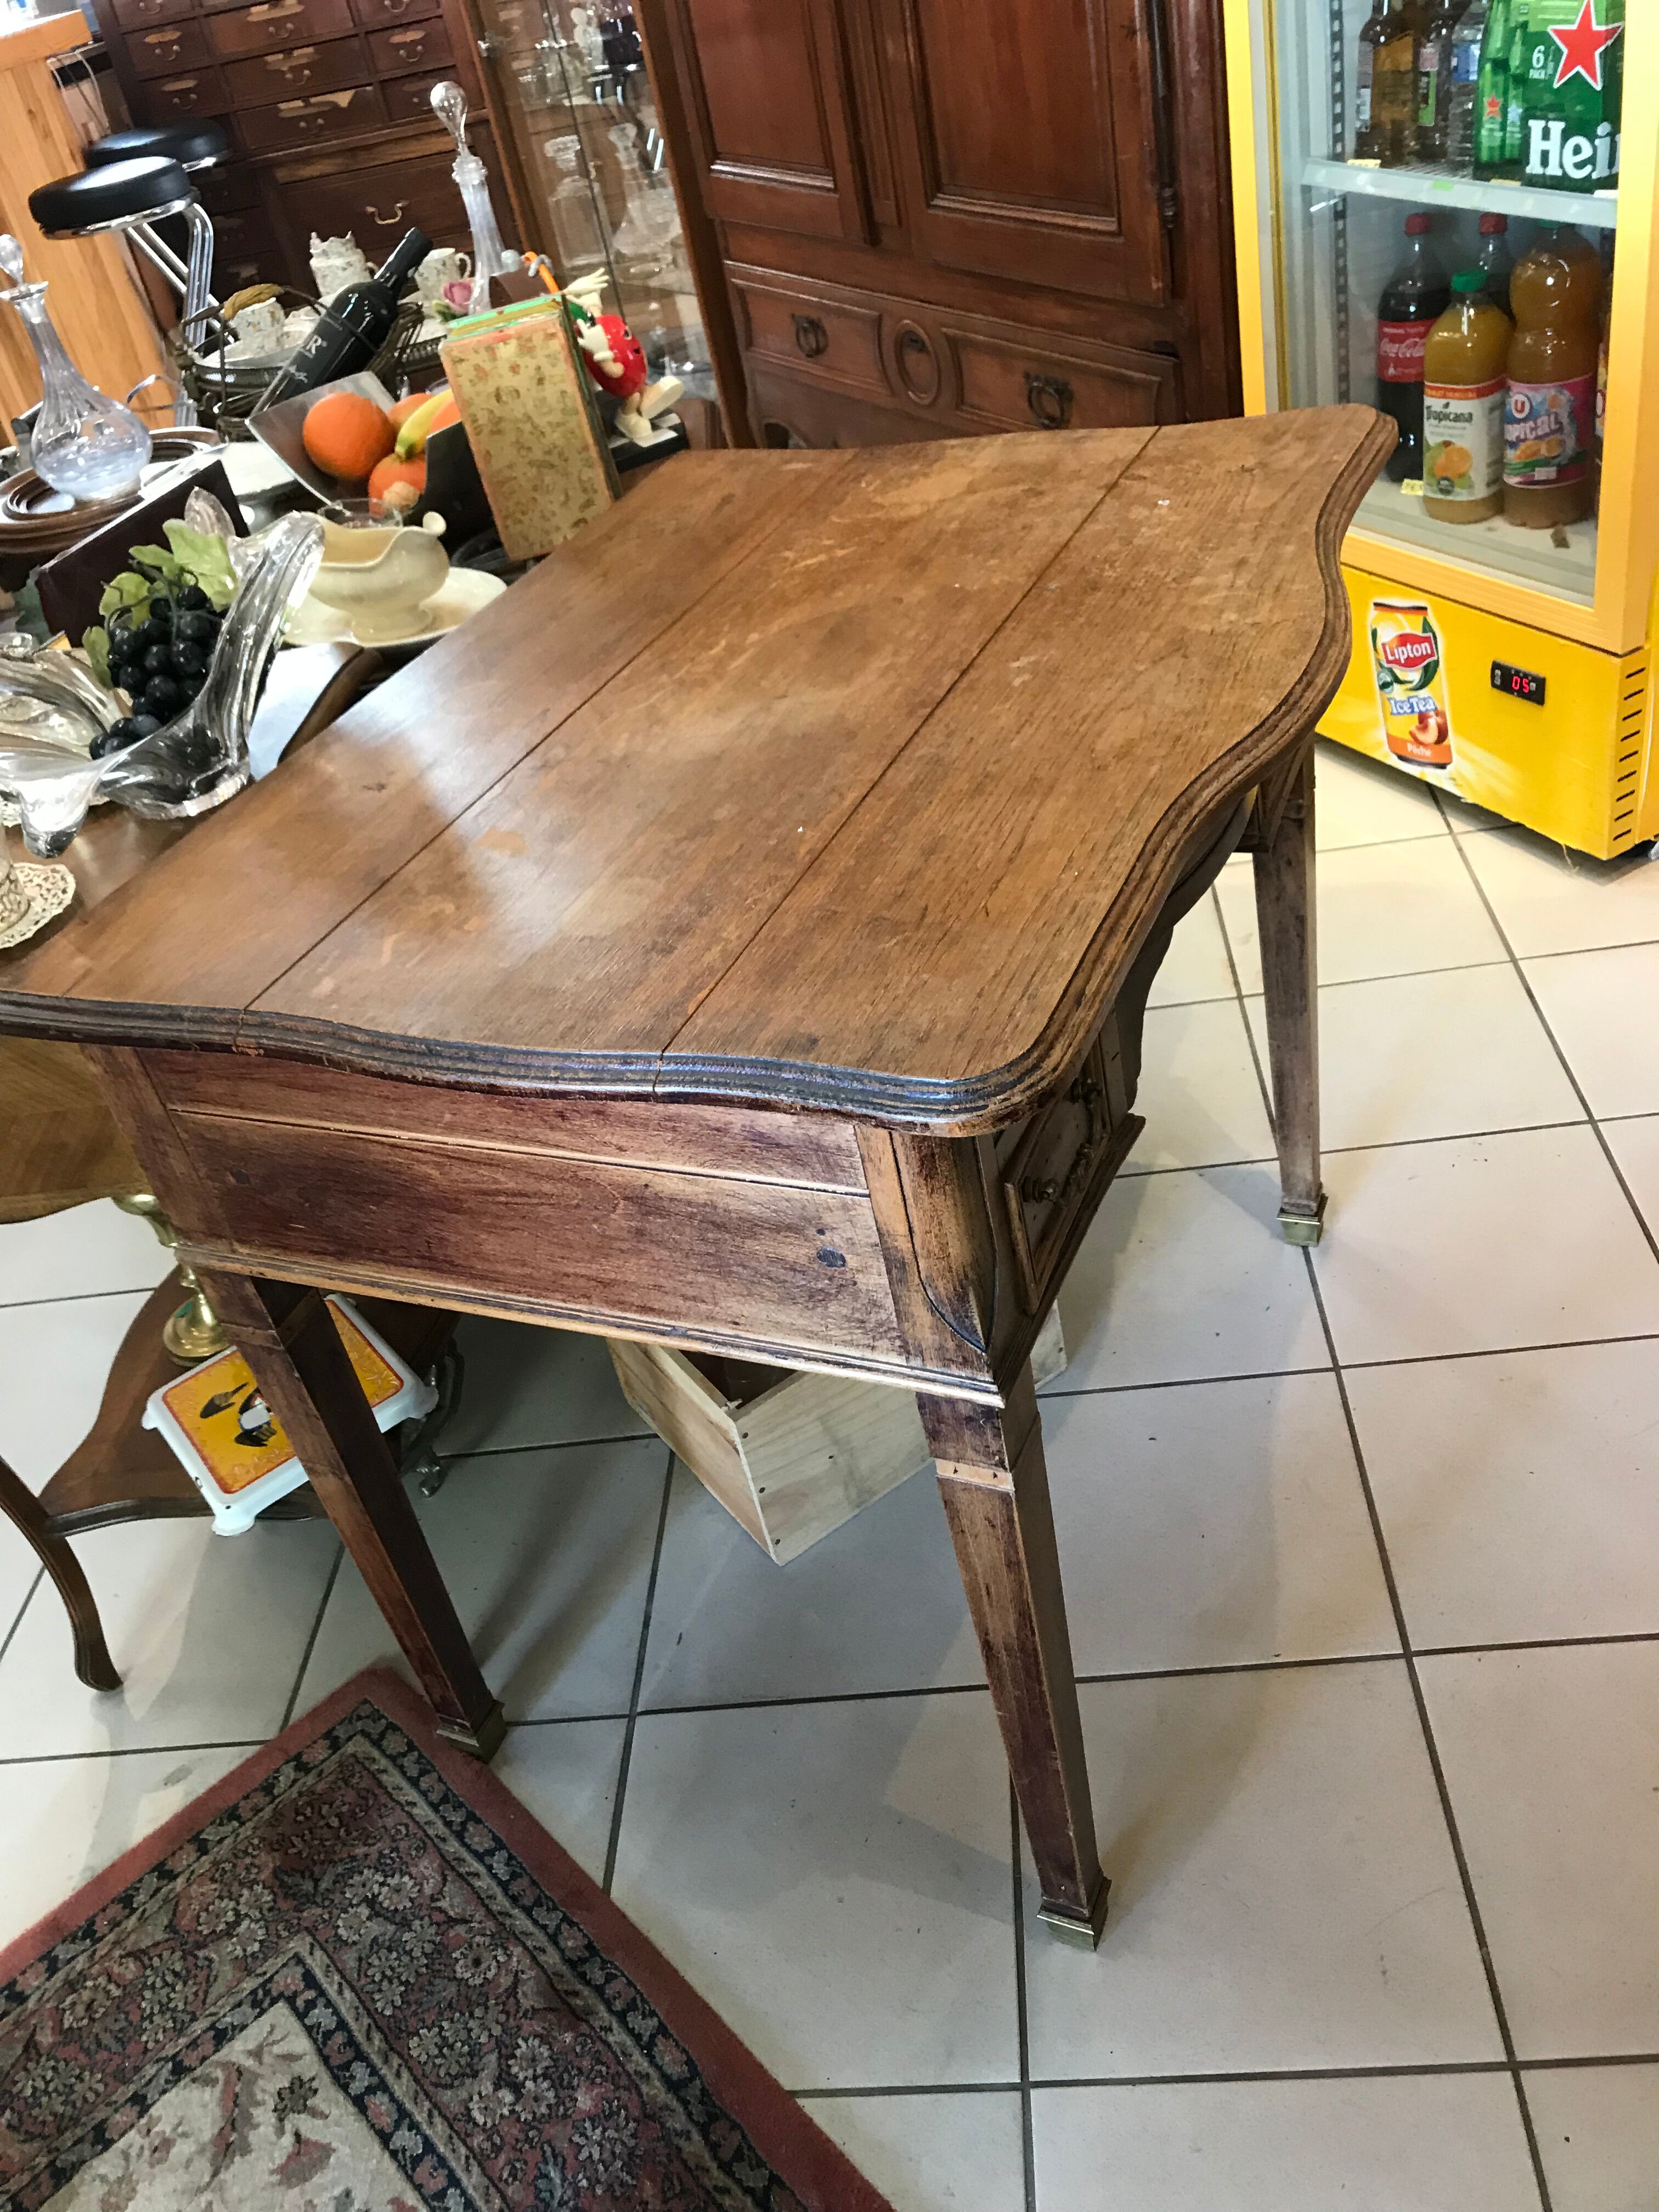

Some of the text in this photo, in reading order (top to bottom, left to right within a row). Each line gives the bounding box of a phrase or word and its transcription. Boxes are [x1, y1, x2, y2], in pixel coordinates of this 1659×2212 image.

[1532, 45, 1545, 68] 6
[1526, 119, 1621, 179] Hei
[1514, 399, 1525, 414] U
[1385, 641, 1431, 663] Lipton
